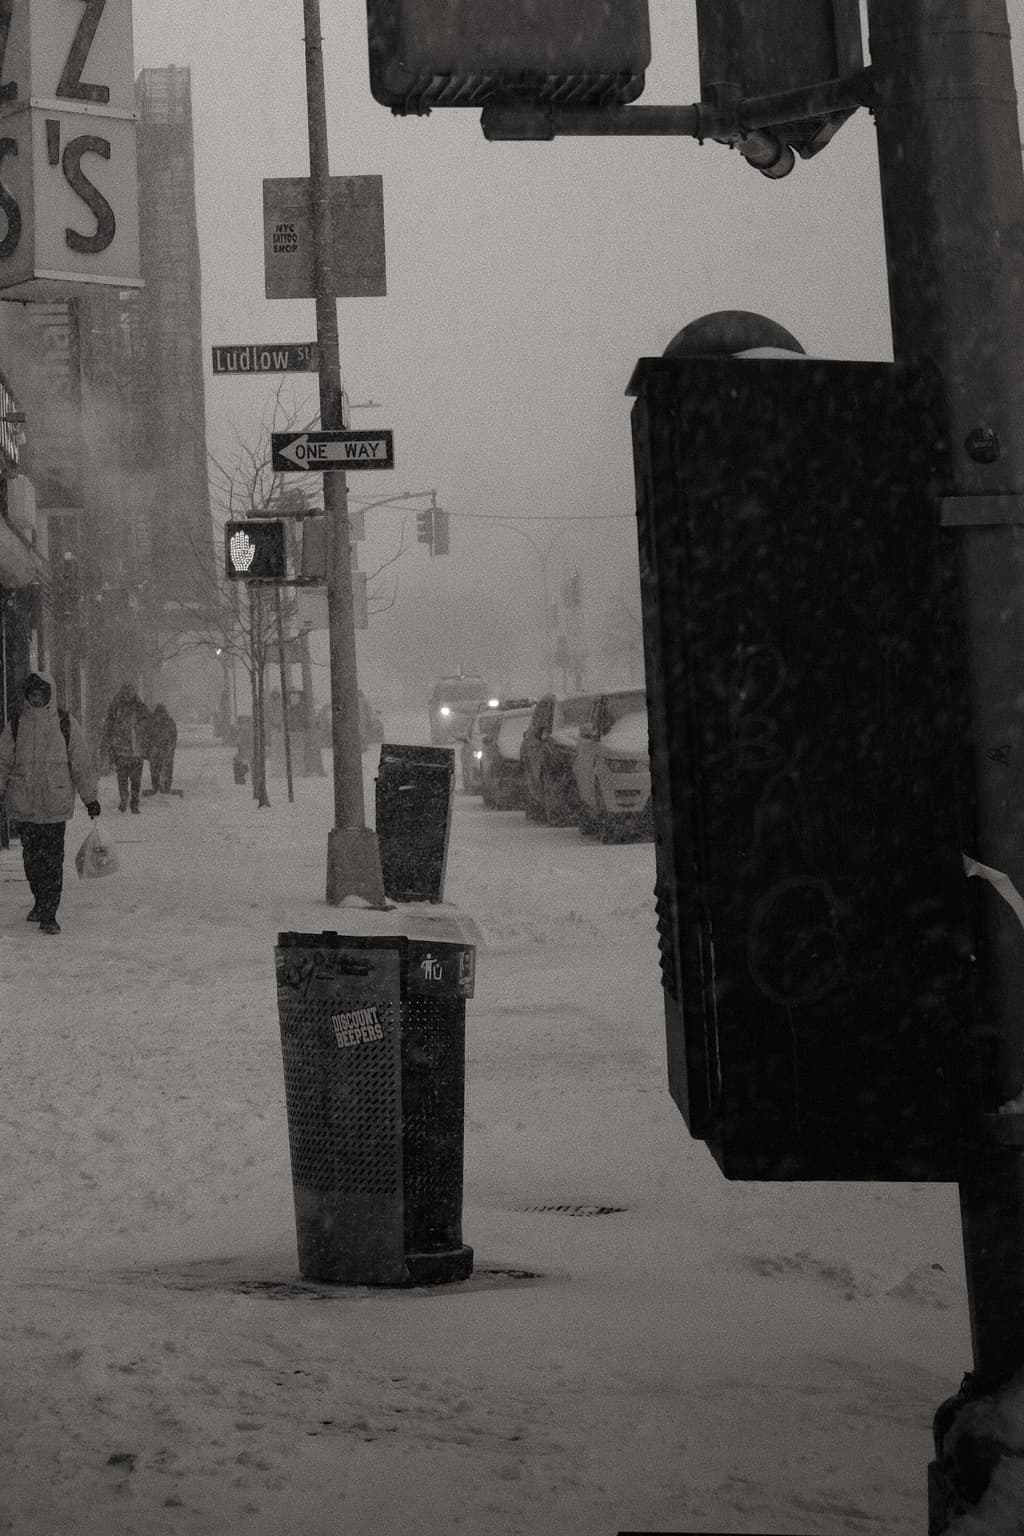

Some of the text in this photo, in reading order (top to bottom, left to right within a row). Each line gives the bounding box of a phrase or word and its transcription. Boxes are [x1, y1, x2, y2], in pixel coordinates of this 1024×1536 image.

[275, 223, 295, 233] NYC
[272, 244, 298, 253] SHOP
[216, 346, 310, 371] Ludlow St
[295, 442, 380, 459] ONE WAY
[331, 1006, 380, 1032] DISCOUNT
[335, 1024, 384, 1049] BEEPERS
